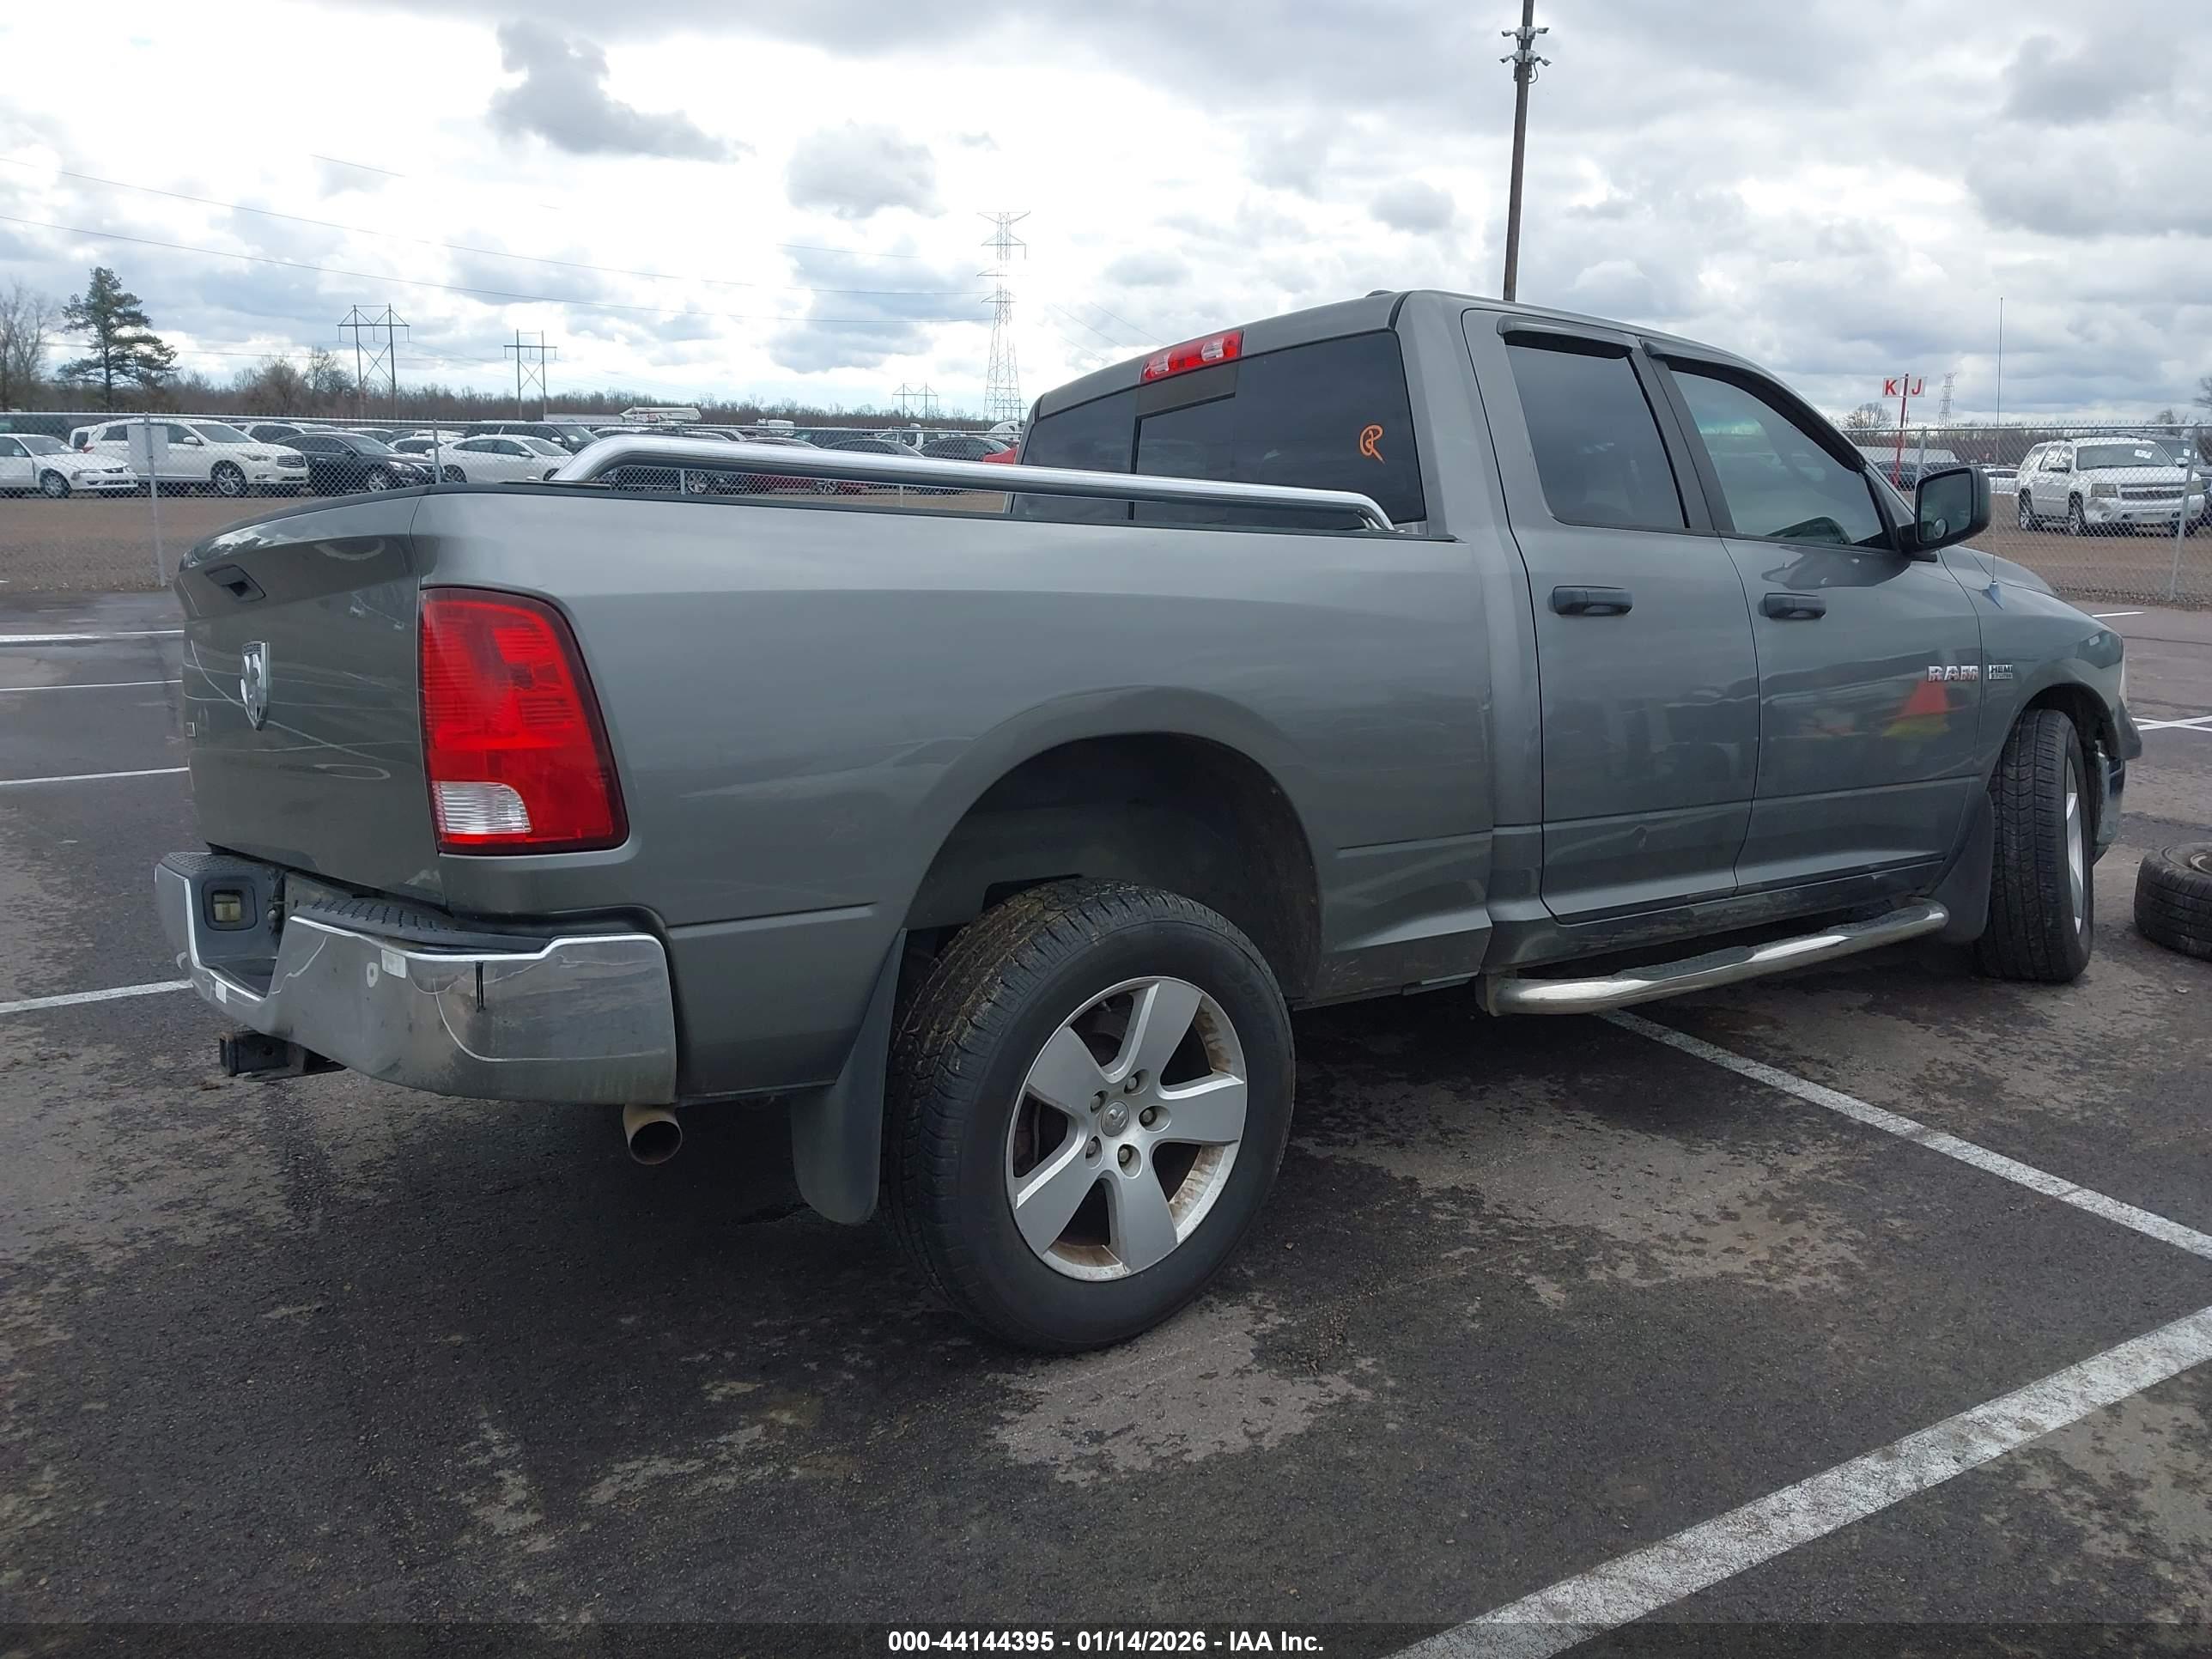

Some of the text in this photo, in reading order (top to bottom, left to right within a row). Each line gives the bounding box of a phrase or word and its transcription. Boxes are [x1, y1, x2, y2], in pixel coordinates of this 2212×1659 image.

[1885, 379, 1923, 396] K J
[1928, 665, 1979, 682] RAM
